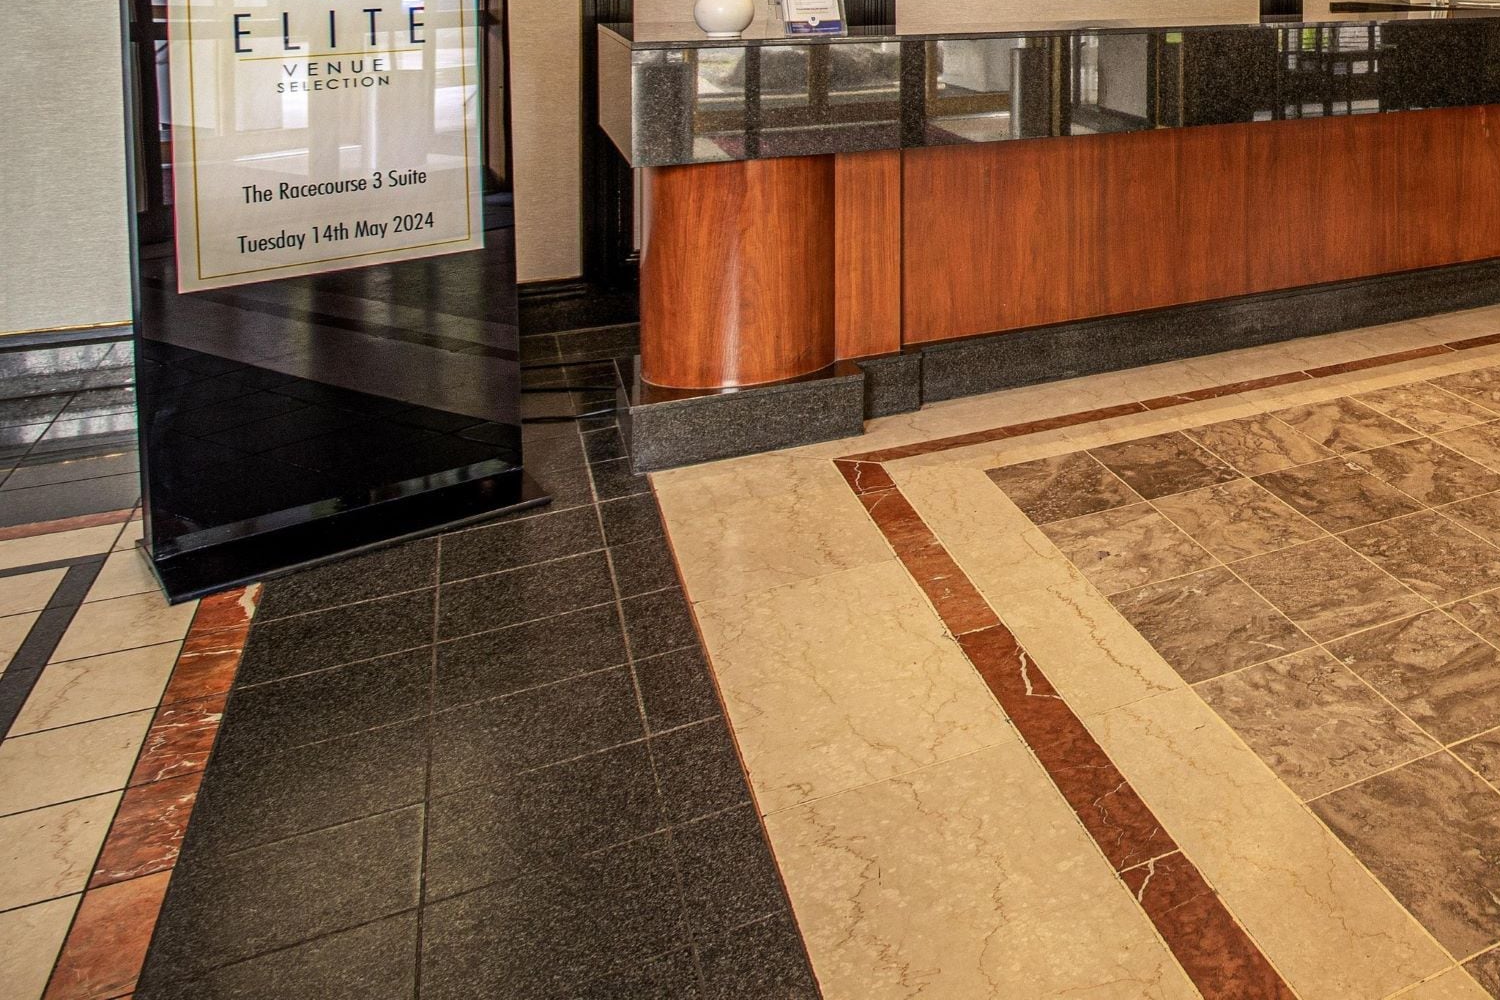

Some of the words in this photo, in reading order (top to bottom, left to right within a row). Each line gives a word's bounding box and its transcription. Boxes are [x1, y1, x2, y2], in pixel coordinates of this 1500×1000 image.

[233, 6, 427, 54] ELITE
[276, 75, 390, 94] SELECTION
[283, 58, 385, 77] VENUE
[242, 184, 273, 204] The
[279, 177, 368, 200] Racecourse
[372, 171, 383, 189] 3
[388, 168, 428, 188] Suite
[237, 230, 306, 254] Tuesday
[312, 222, 349, 244] 14th
[354, 220, 388, 239] May
[392, 211, 435, 233] 2024
